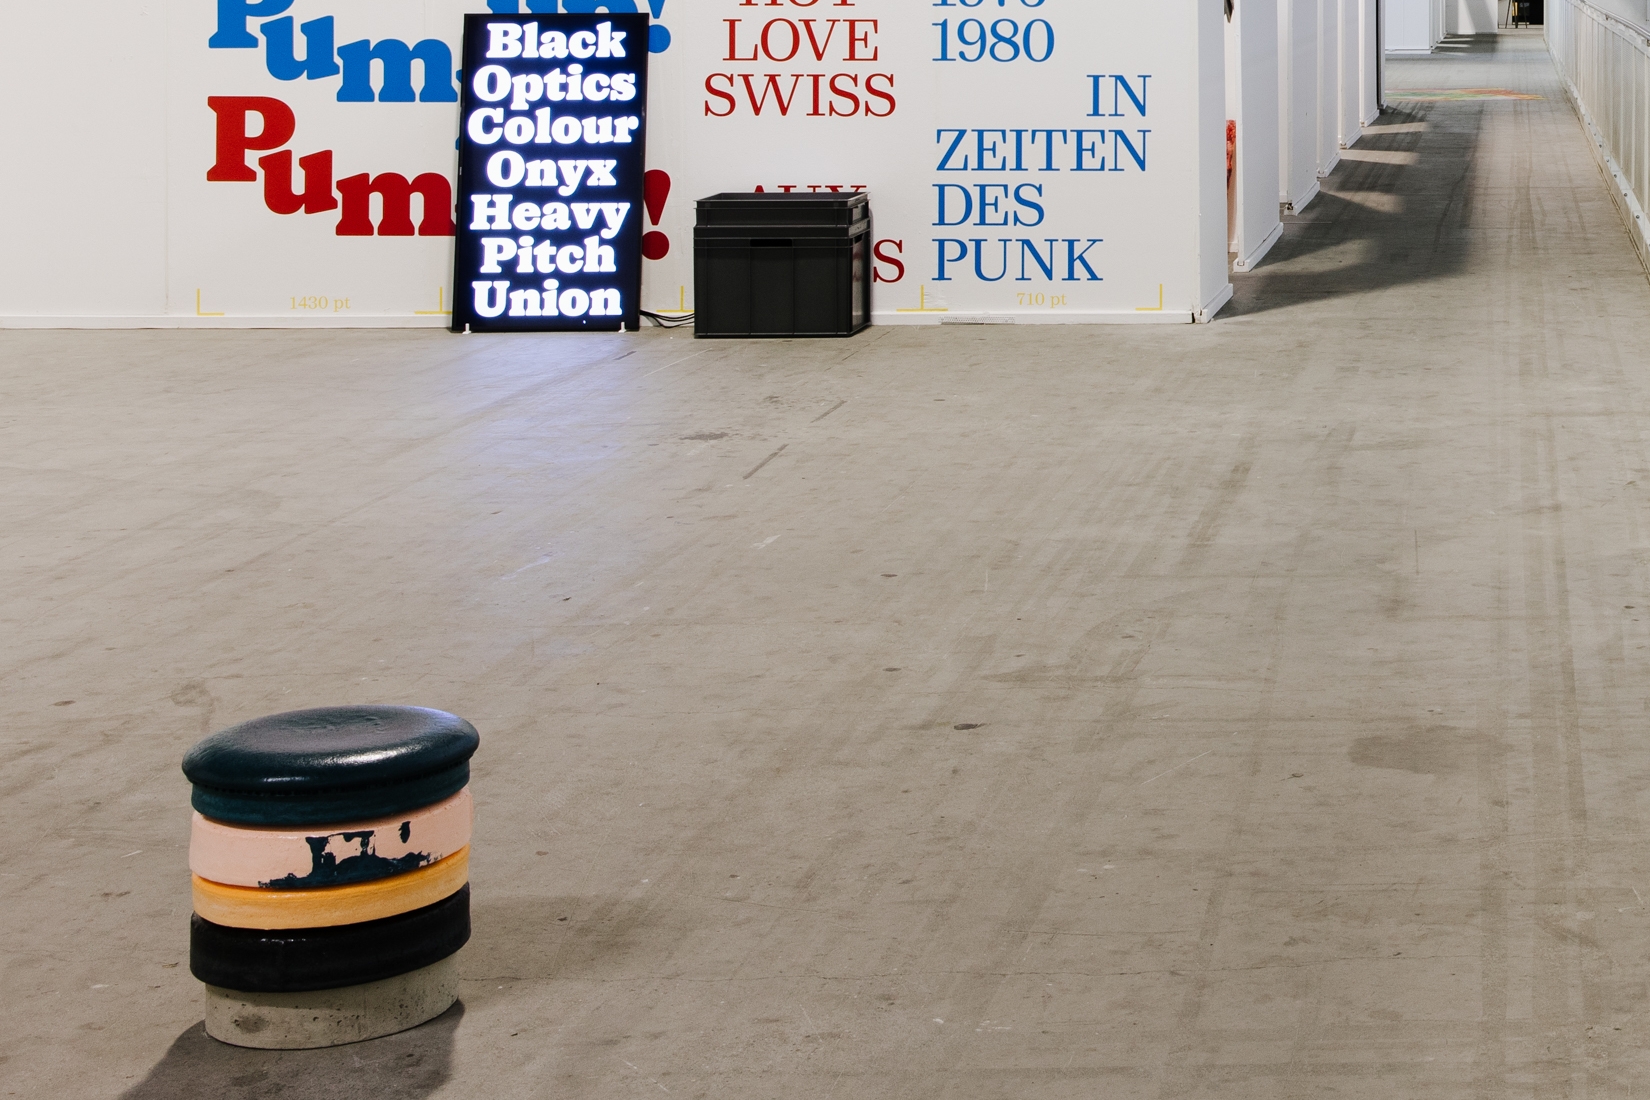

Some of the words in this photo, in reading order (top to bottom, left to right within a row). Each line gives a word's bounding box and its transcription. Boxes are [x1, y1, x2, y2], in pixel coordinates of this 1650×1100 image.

[485, 21, 627, 60] Black
[722, 18, 879, 62] LOVE
[931, 18, 1055, 63] 1980
[472, 63, 636, 111] Optics
[704, 72, 896, 118] SWISS
[1086, 74, 1152, 117] IN
[467, 106, 639, 145] Colour
[935, 128, 1152, 172] ZEITEN
[486, 149, 617, 196] Onyx
[469, 194, 631, 239] Heavy
[931, 183, 1045, 228] DES
[480, 235, 617, 274] Pitch
[931, 238, 1104, 282] PUNK
[289, 295, 328, 310] 1430
[332, 297, 351, 313] pt
[472, 278, 622, 318] Union
[1017, 292, 1044, 307] 710
[1047, 294, 1067, 310] pt
